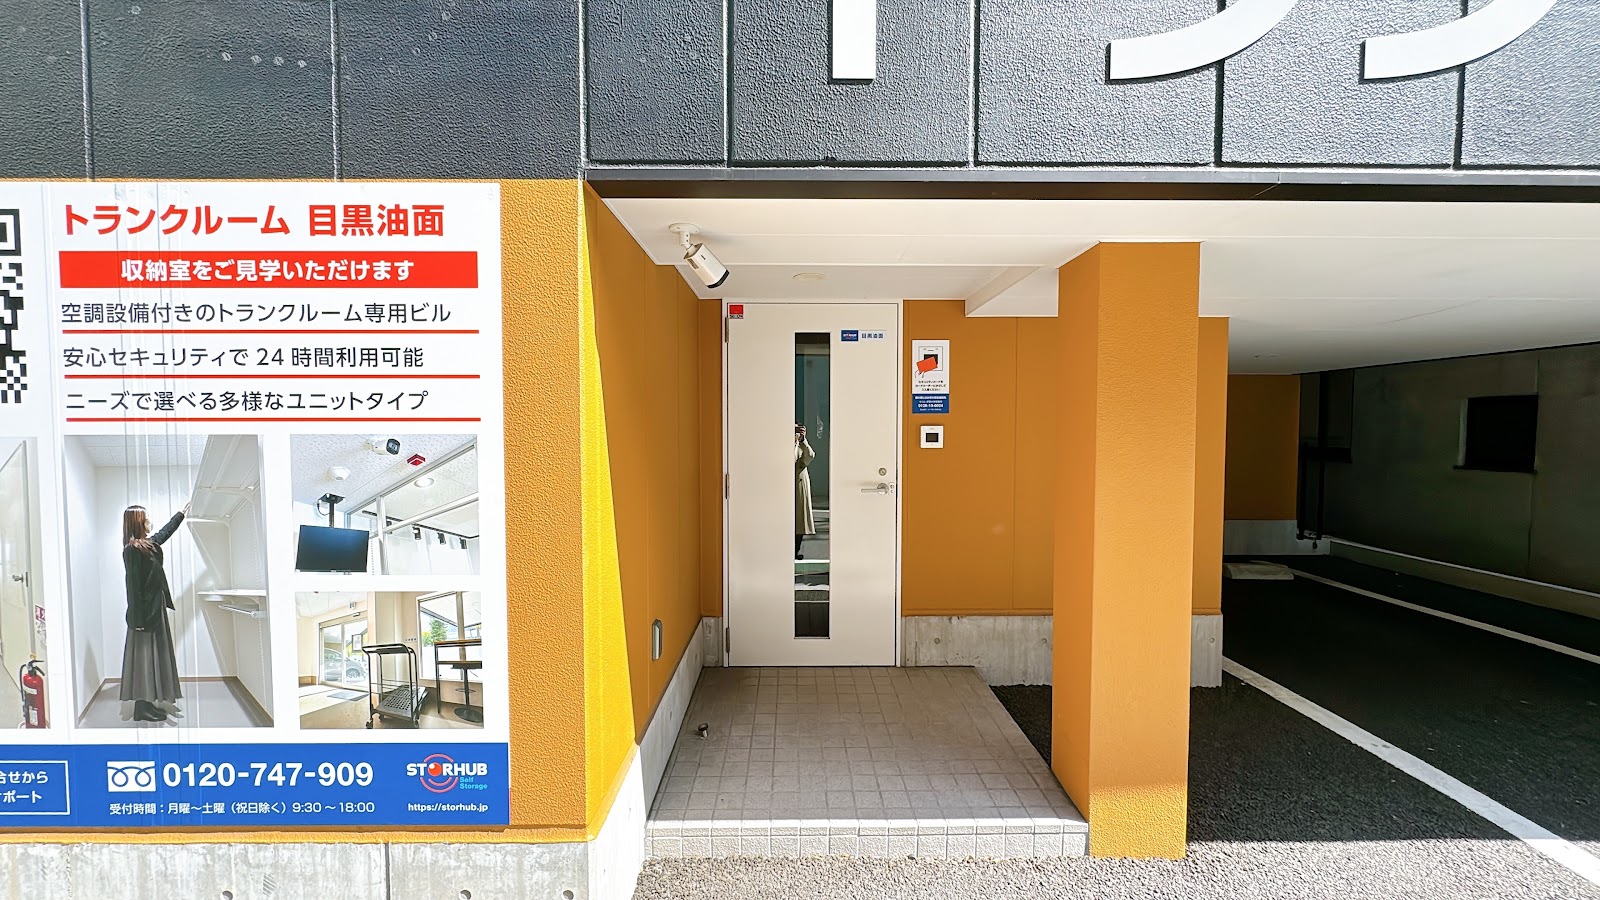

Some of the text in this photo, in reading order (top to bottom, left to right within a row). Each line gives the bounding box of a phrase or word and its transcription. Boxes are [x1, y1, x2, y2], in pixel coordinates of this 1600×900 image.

[65, 203, 445, 238] トランクルーム 目黒油面
[121, 258, 415, 282] 収納室をご見学いただけます
[61, 302, 451, 325] 空調設備付きのトランクルーム専用ビル
[63, 346, 424, 369] 安心セキュリティで 24 時間利用可能
[66, 390, 429, 412] ニーズで選べる多様なユニットタイプ
[162, 761, 374, 788] 0120-747-909
[406, 762, 488, 776] STORHUB
[0, 789, 42, 804] ポート
[407, 802, 489, 813] https://storhub.jp
